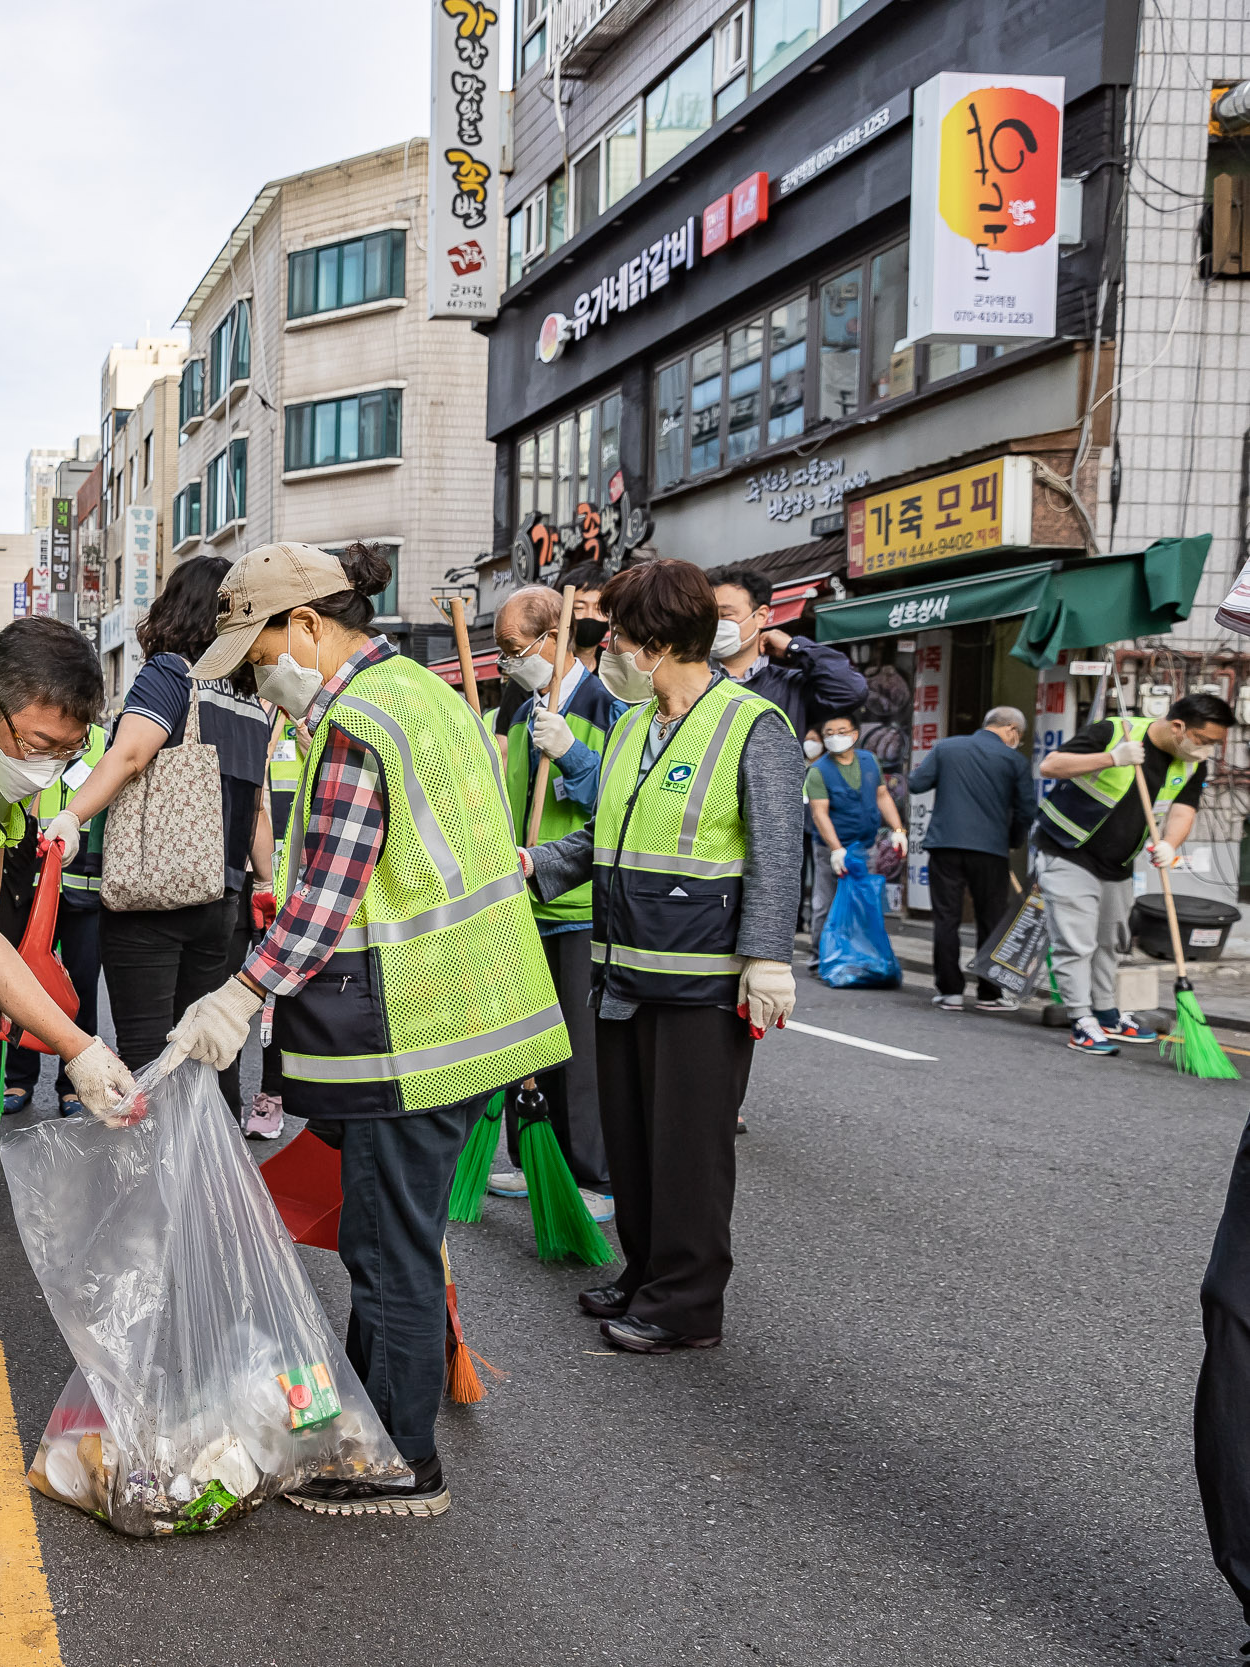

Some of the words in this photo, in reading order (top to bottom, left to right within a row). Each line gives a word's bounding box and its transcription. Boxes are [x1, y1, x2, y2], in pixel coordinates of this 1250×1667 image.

[572, 216, 694, 341] 유가네닭갈비
[953, 310, 1034, 325] 070-4191-1253
[869, 495, 923, 547] 가죽
[934, 472, 999, 531] 모피
[53, 528, 70, 580] 노래방
[888, 594, 951, 628] 성호상사
